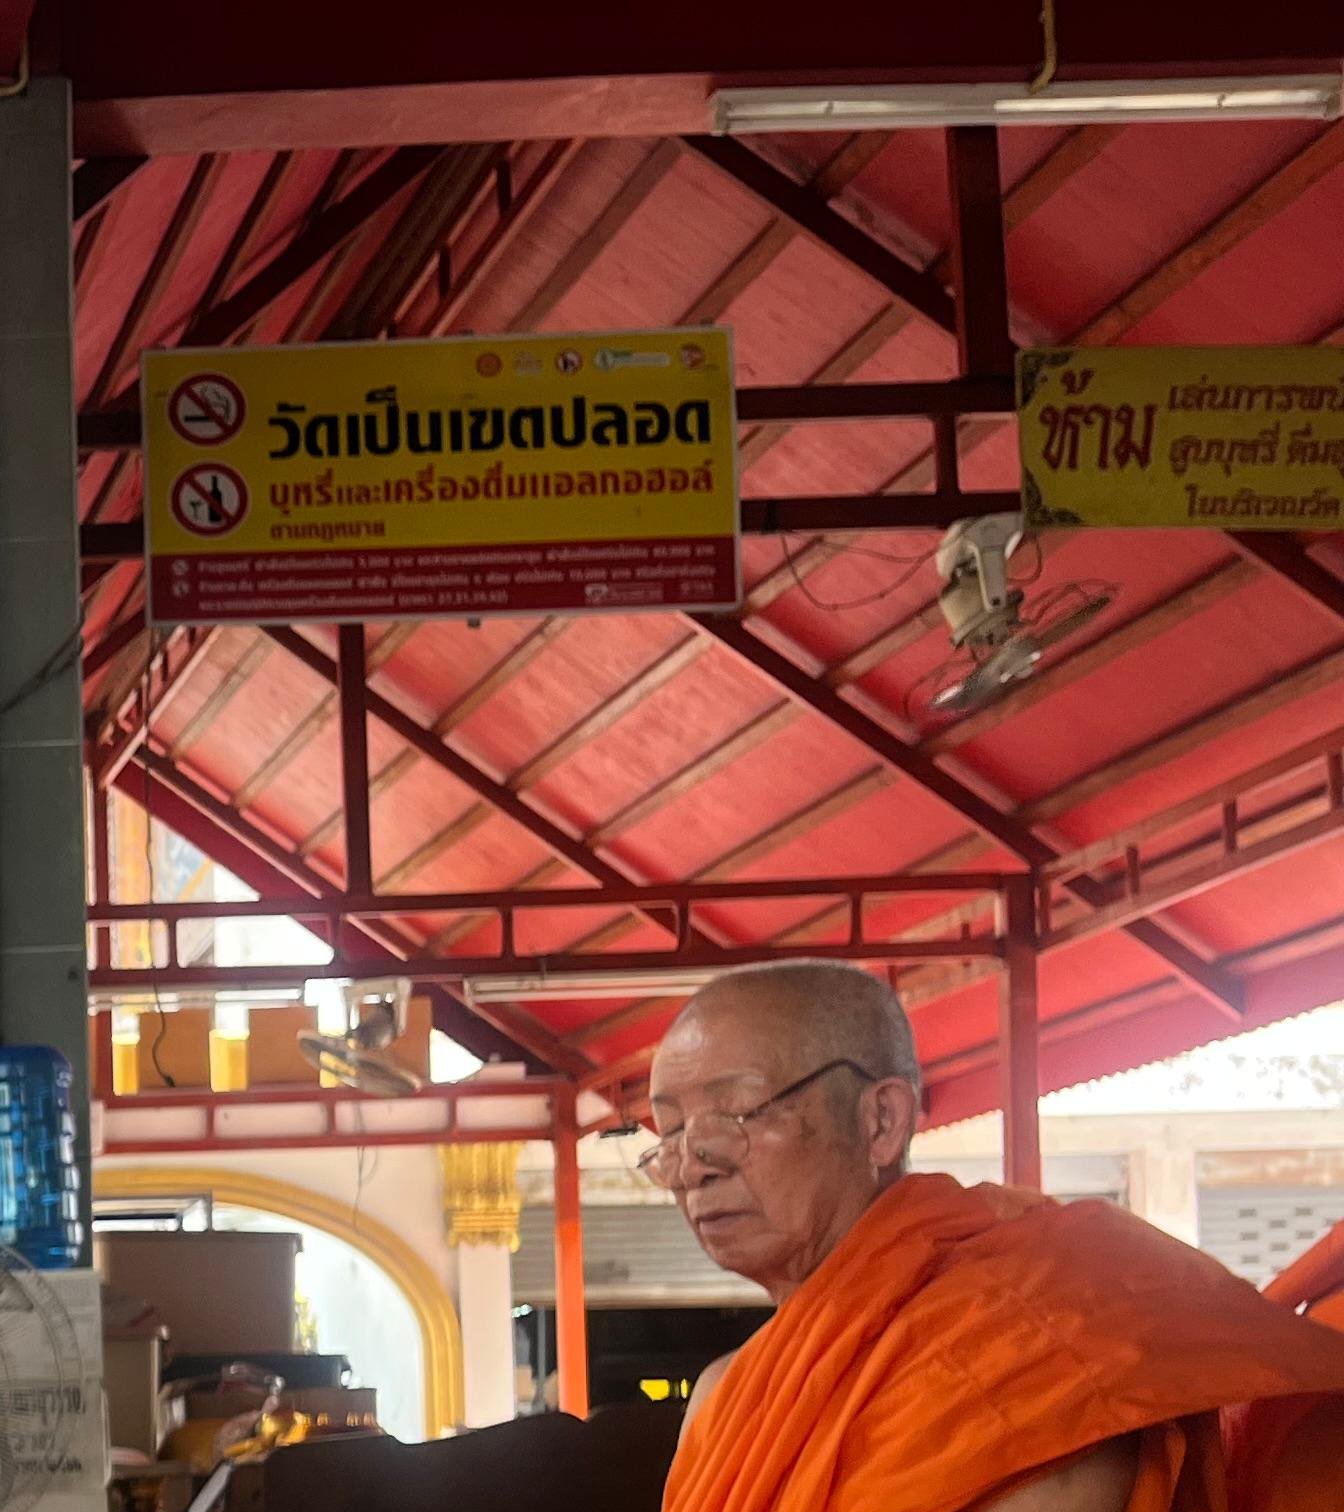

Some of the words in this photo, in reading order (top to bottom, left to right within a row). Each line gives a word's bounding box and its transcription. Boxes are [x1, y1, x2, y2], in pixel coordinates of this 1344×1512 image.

[267, 385, 713, 460] วัดเป็นเขตปลอด
[1038, 367, 1158, 472] ห้าม
[1169, 419, 1280, 478] สูบบุหรี่
[268, 458, 715, 517] บุหรี่และเครื่องดื่มแอลกอฮอล์
